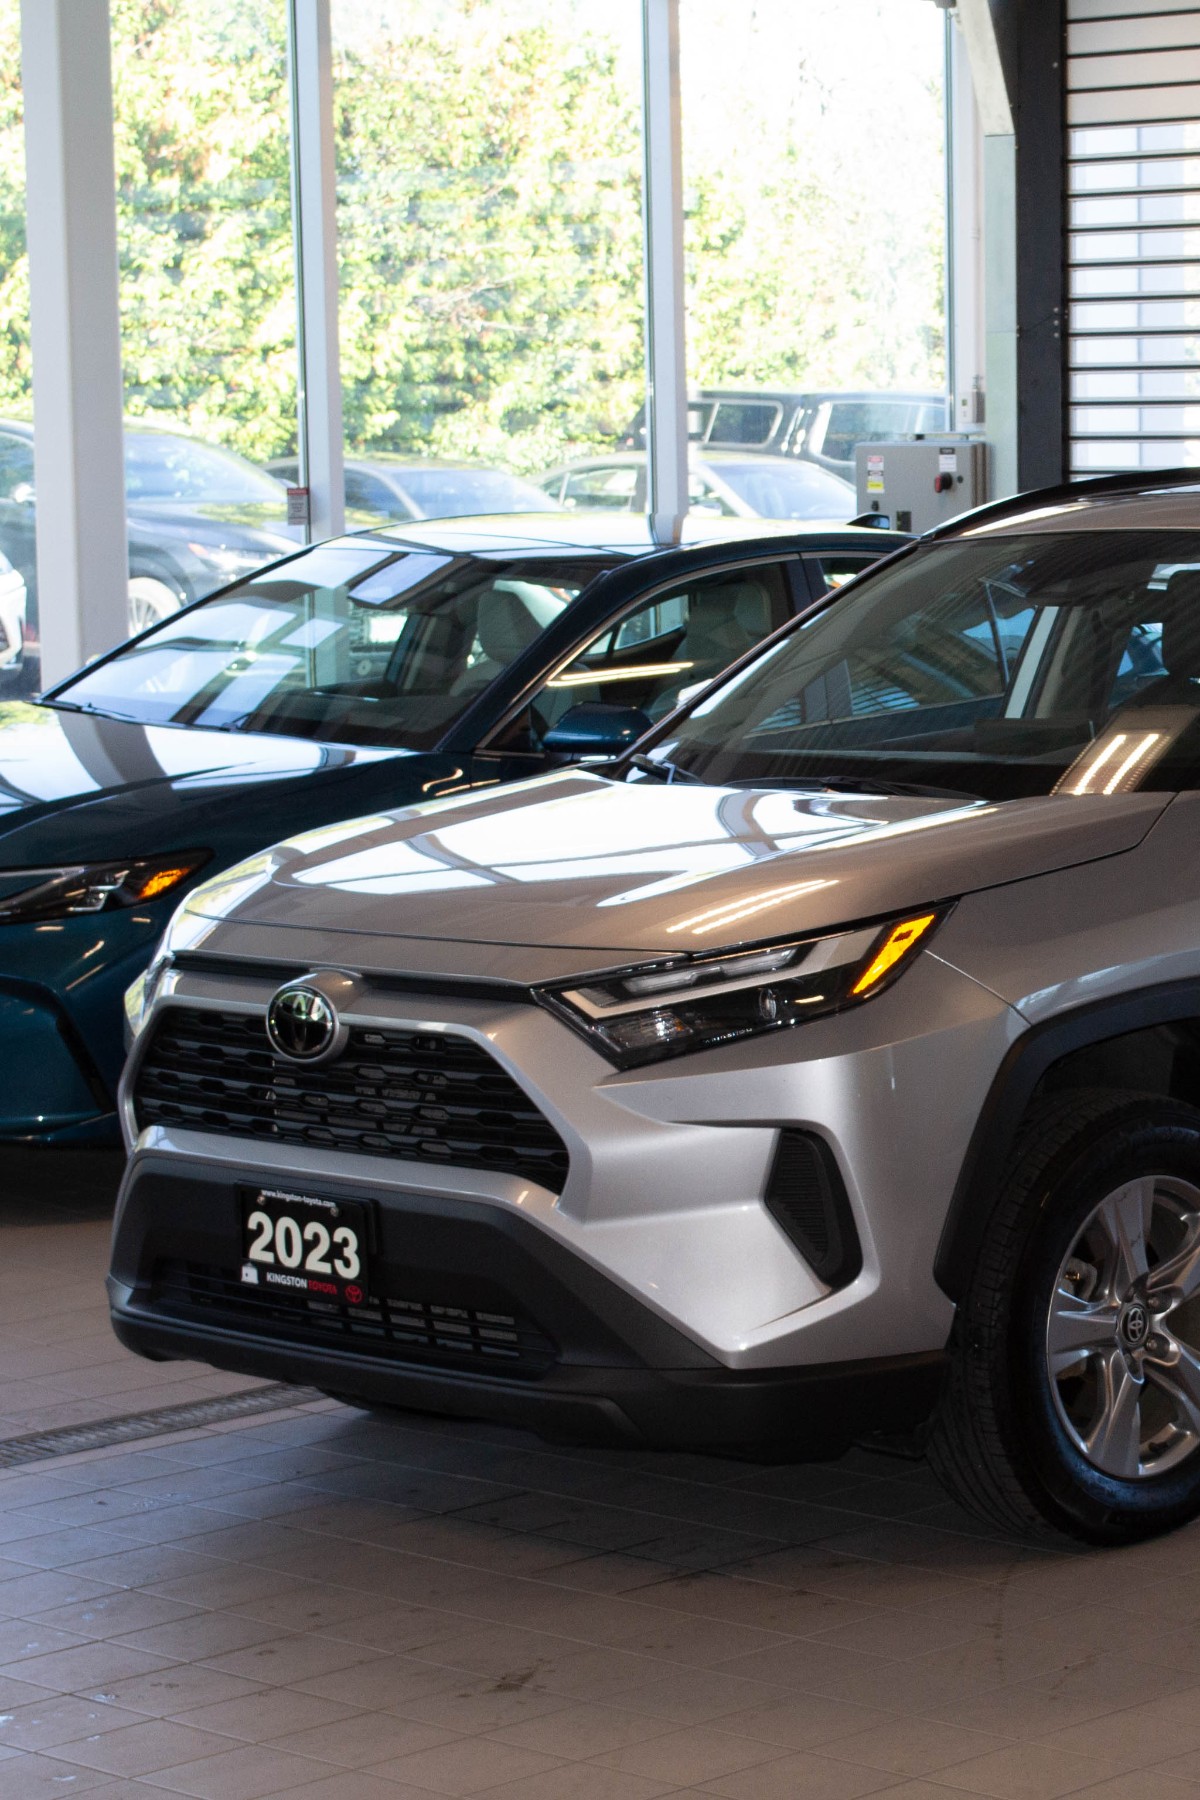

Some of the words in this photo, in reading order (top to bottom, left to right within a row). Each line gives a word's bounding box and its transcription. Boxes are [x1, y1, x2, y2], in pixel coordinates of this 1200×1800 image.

[261, 1189, 336, 1207] www.kingston-toyota.com
[247, 1211, 361, 1280] 2023
[266, 1272, 308, 1289] KINGSTON
[308, 1280, 338, 1295] TOYOTA
